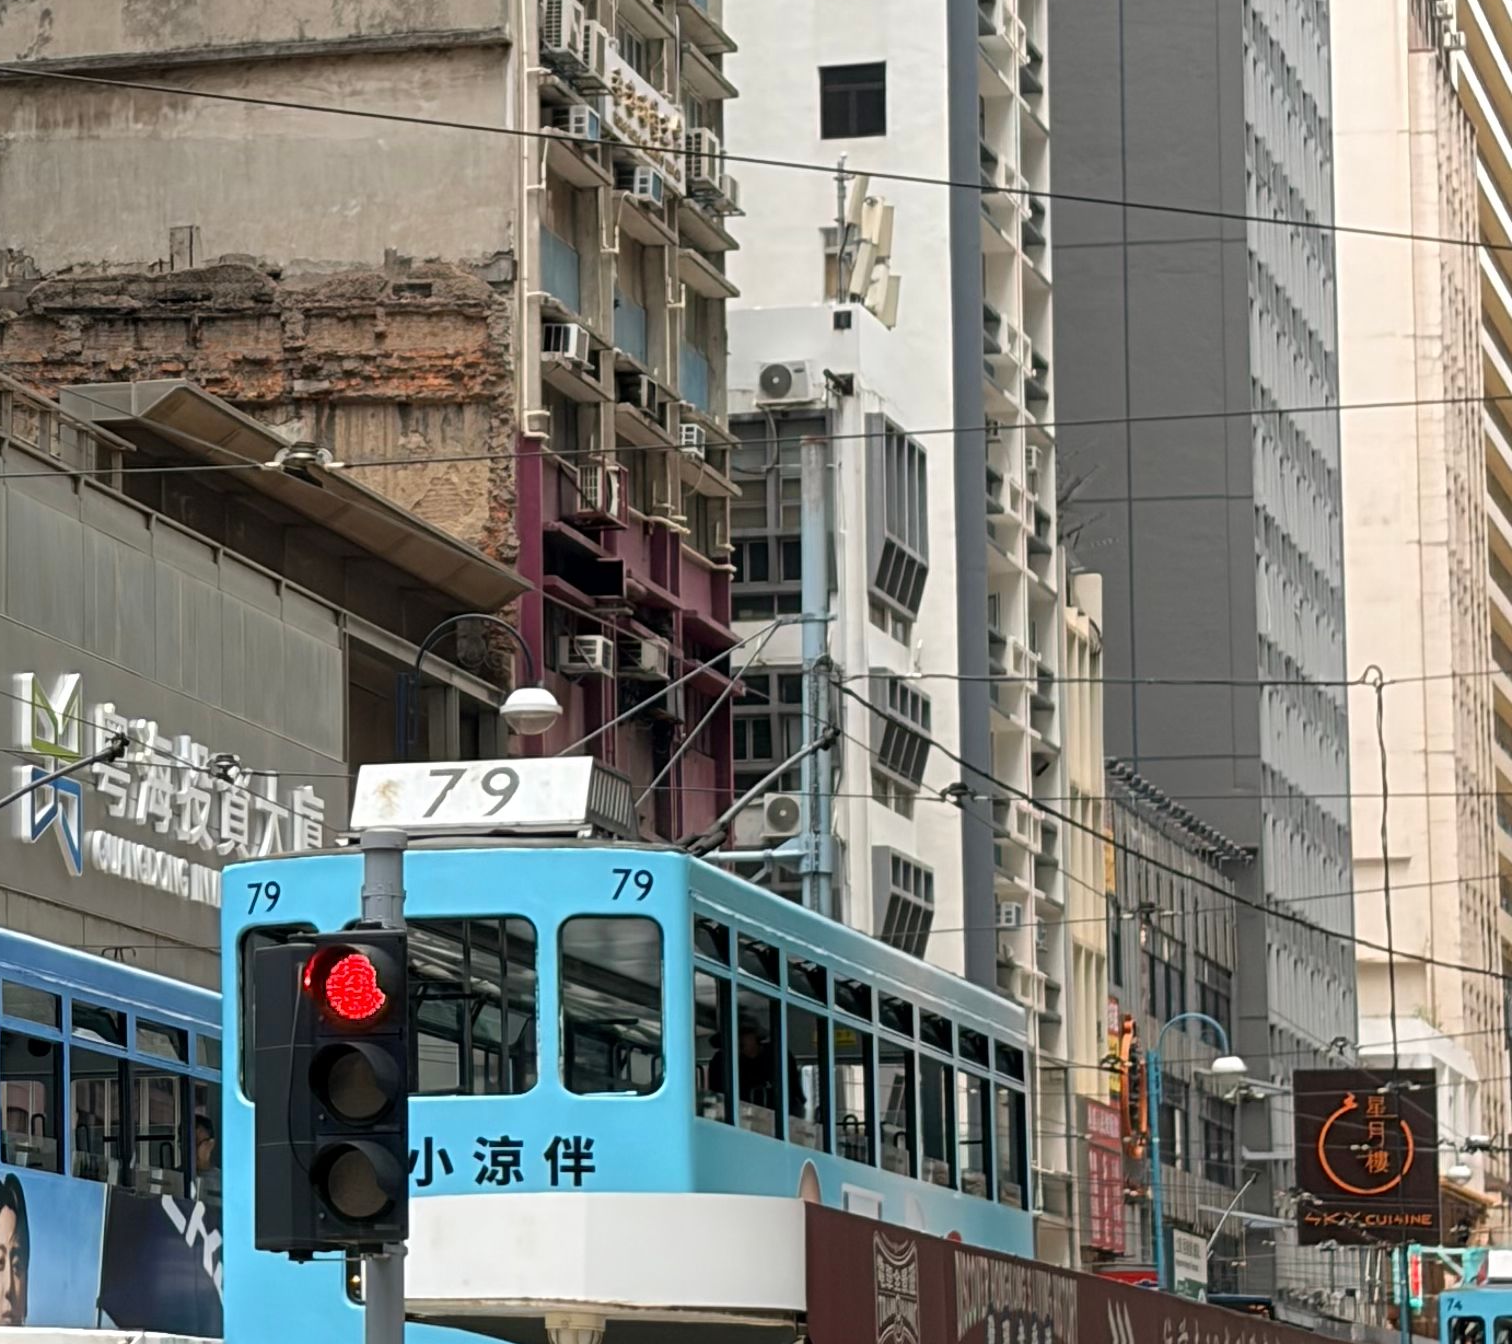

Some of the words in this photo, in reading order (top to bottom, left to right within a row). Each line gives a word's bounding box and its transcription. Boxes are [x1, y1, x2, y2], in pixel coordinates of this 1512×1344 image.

[422, 767, 521, 818] 79
[246, 880, 281, 916] 79
[610, 867, 654, 902] 79
[1364, 1096, 1390, 1173] 星月樓
[407, 1136, 596, 1188] 小涼伴
[1446, 1299, 1462, 1312] 74
